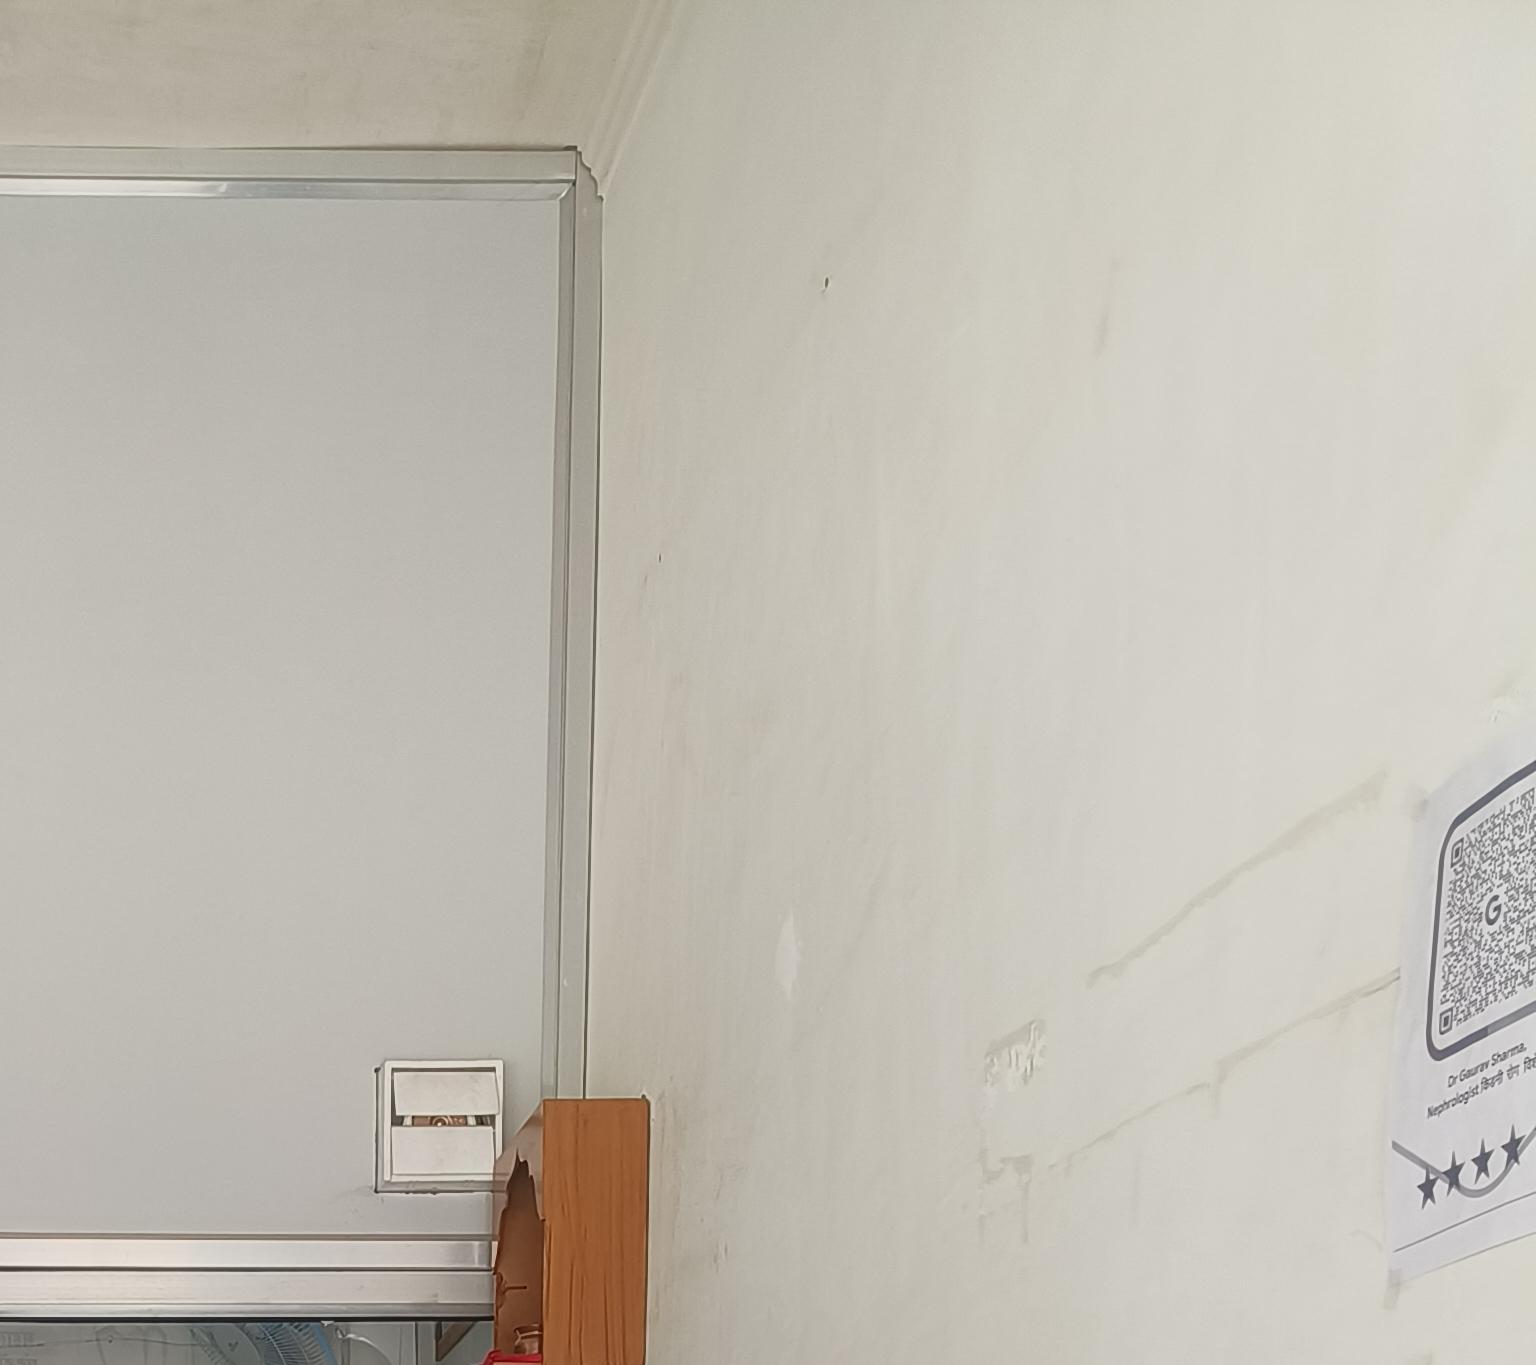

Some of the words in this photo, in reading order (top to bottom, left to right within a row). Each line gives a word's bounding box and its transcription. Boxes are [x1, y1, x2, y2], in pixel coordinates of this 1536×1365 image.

[1448, 1075, 1459, 1088] Dr
[1459, 1060, 1490, 1082] Gaurav
[1427, 1084, 1480, 1119] Nephrologist
